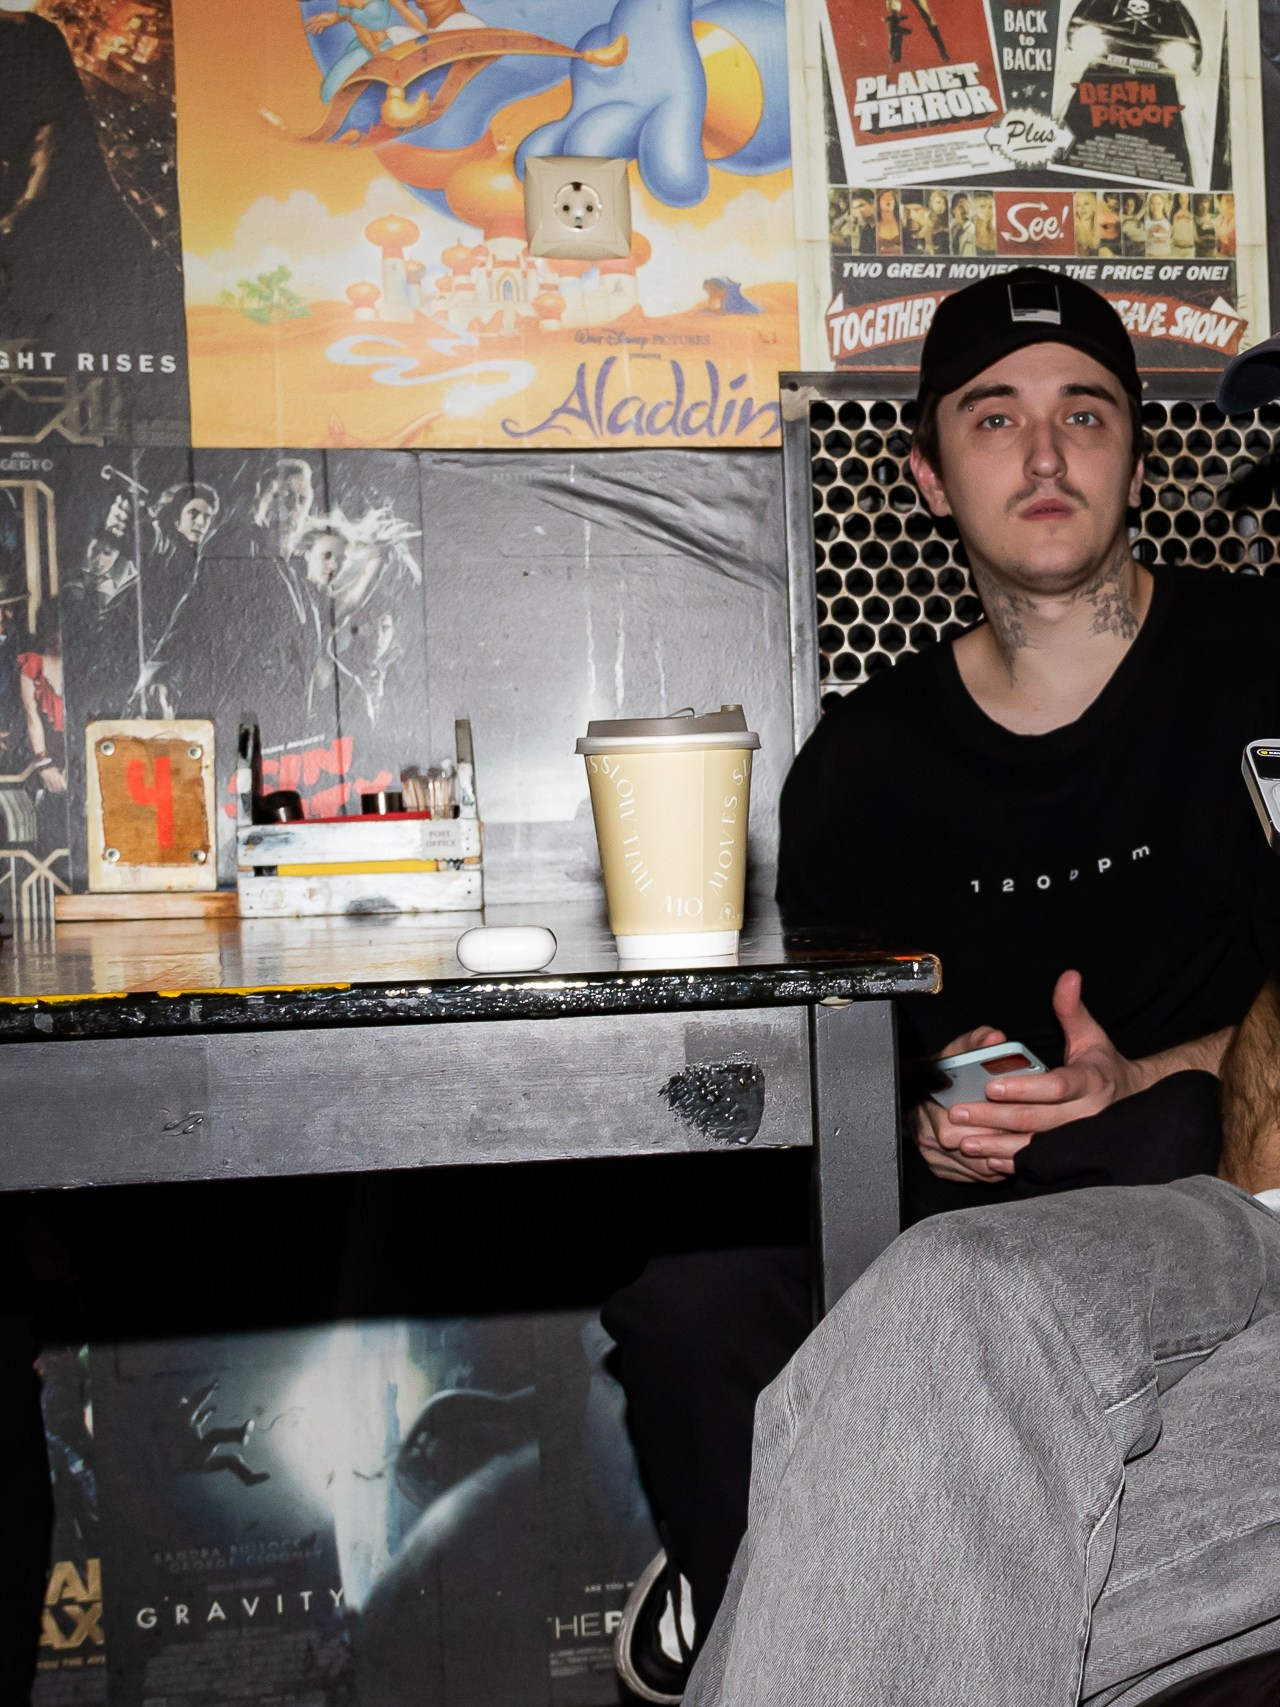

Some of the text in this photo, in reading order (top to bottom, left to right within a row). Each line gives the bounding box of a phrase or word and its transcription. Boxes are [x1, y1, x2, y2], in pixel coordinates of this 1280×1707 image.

[1003, 9, 1048, 34] BACK
[1017, 33, 1036, 47] to
[1002, 47, 1052, 72] BACK!
[855, 62, 980, 103] PLANET
[854, 85, 999, 131] TERROR
[1006, 120, 1057, 145] Plus
[1000, 202, 1069, 243] See!
[842, 262, 883, 278] TWO
[886, 262, 946, 279] GREAT
[1065, 264, 1099, 280] THE
[1100, 265, 1156, 281] PRICE
[1158, 265, 1184, 281] OF
[1186, 266, 1229, 281] ONE!
[829, 297, 937, 356] TOGETHER
[1169, 306, 1240, 348] SHOW
[77, 353, 177, 374] RISES
[501, 355, 780, 439] Aladdin
[126, 755, 174, 849] 4
[136, 1587, 346, 1629] GRAVITY
